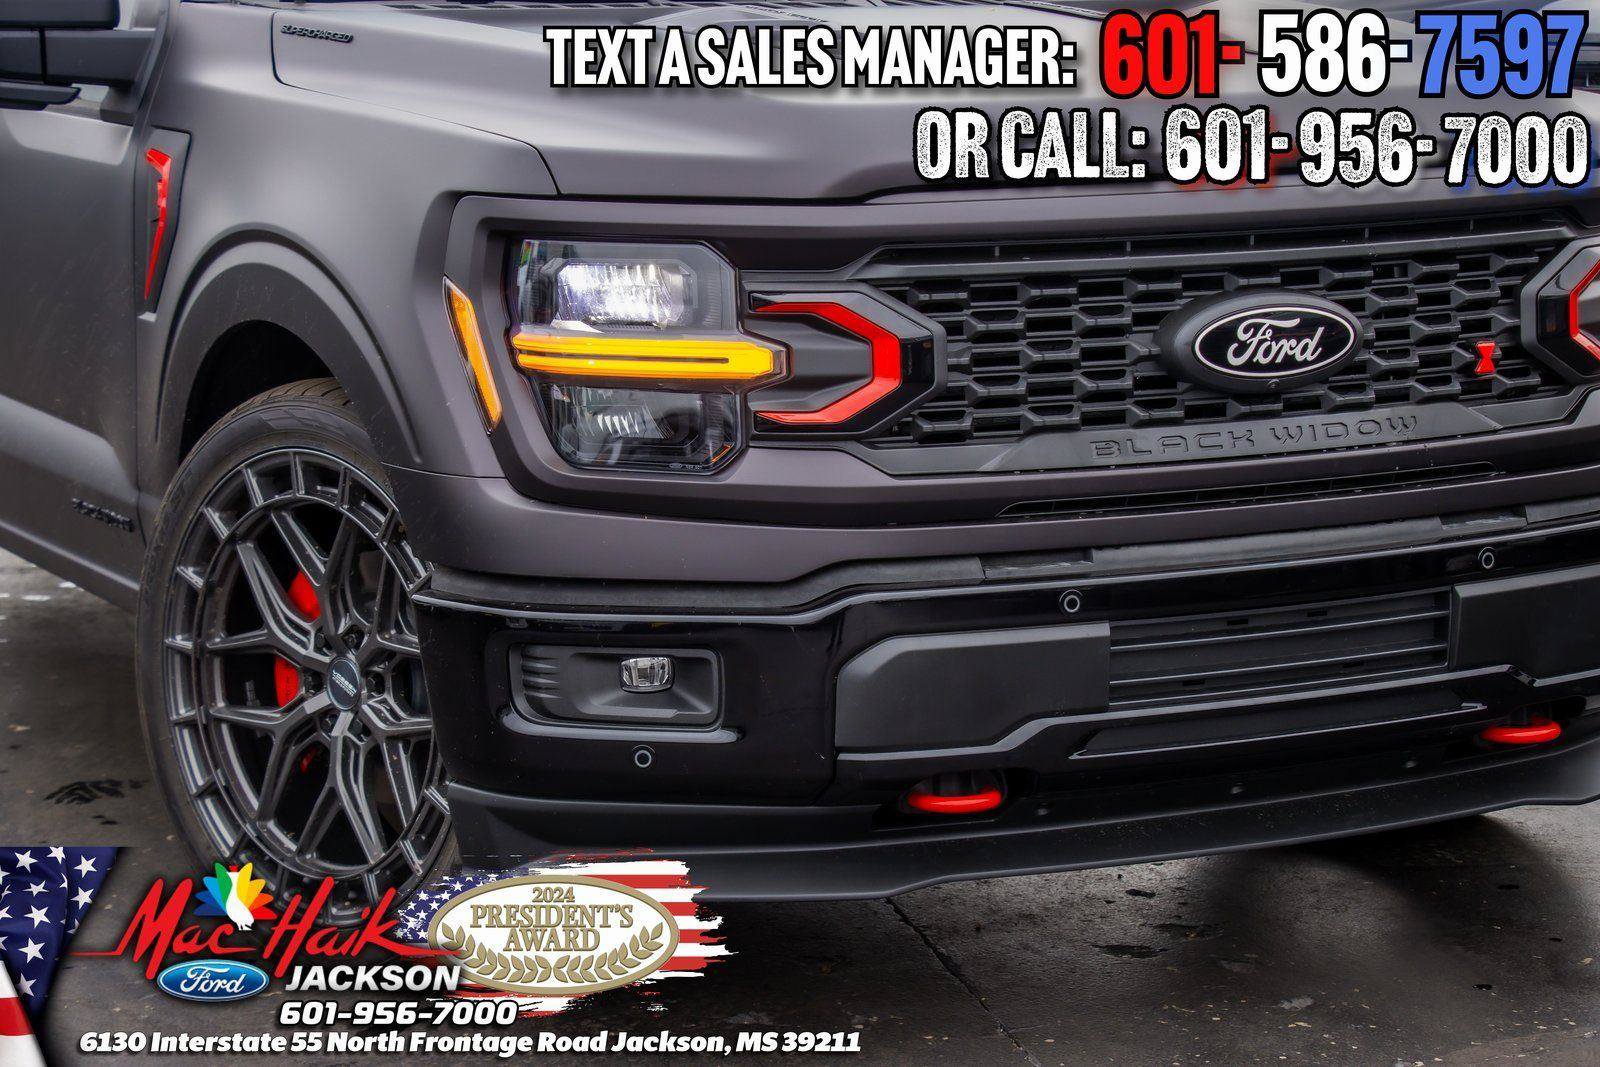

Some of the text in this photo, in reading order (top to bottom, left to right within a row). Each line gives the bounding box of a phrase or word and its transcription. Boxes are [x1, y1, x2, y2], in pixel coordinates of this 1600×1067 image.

[1227, 317, 1325, 366] Ford
[1089, 415, 1419, 459] BLACK WIDOW
